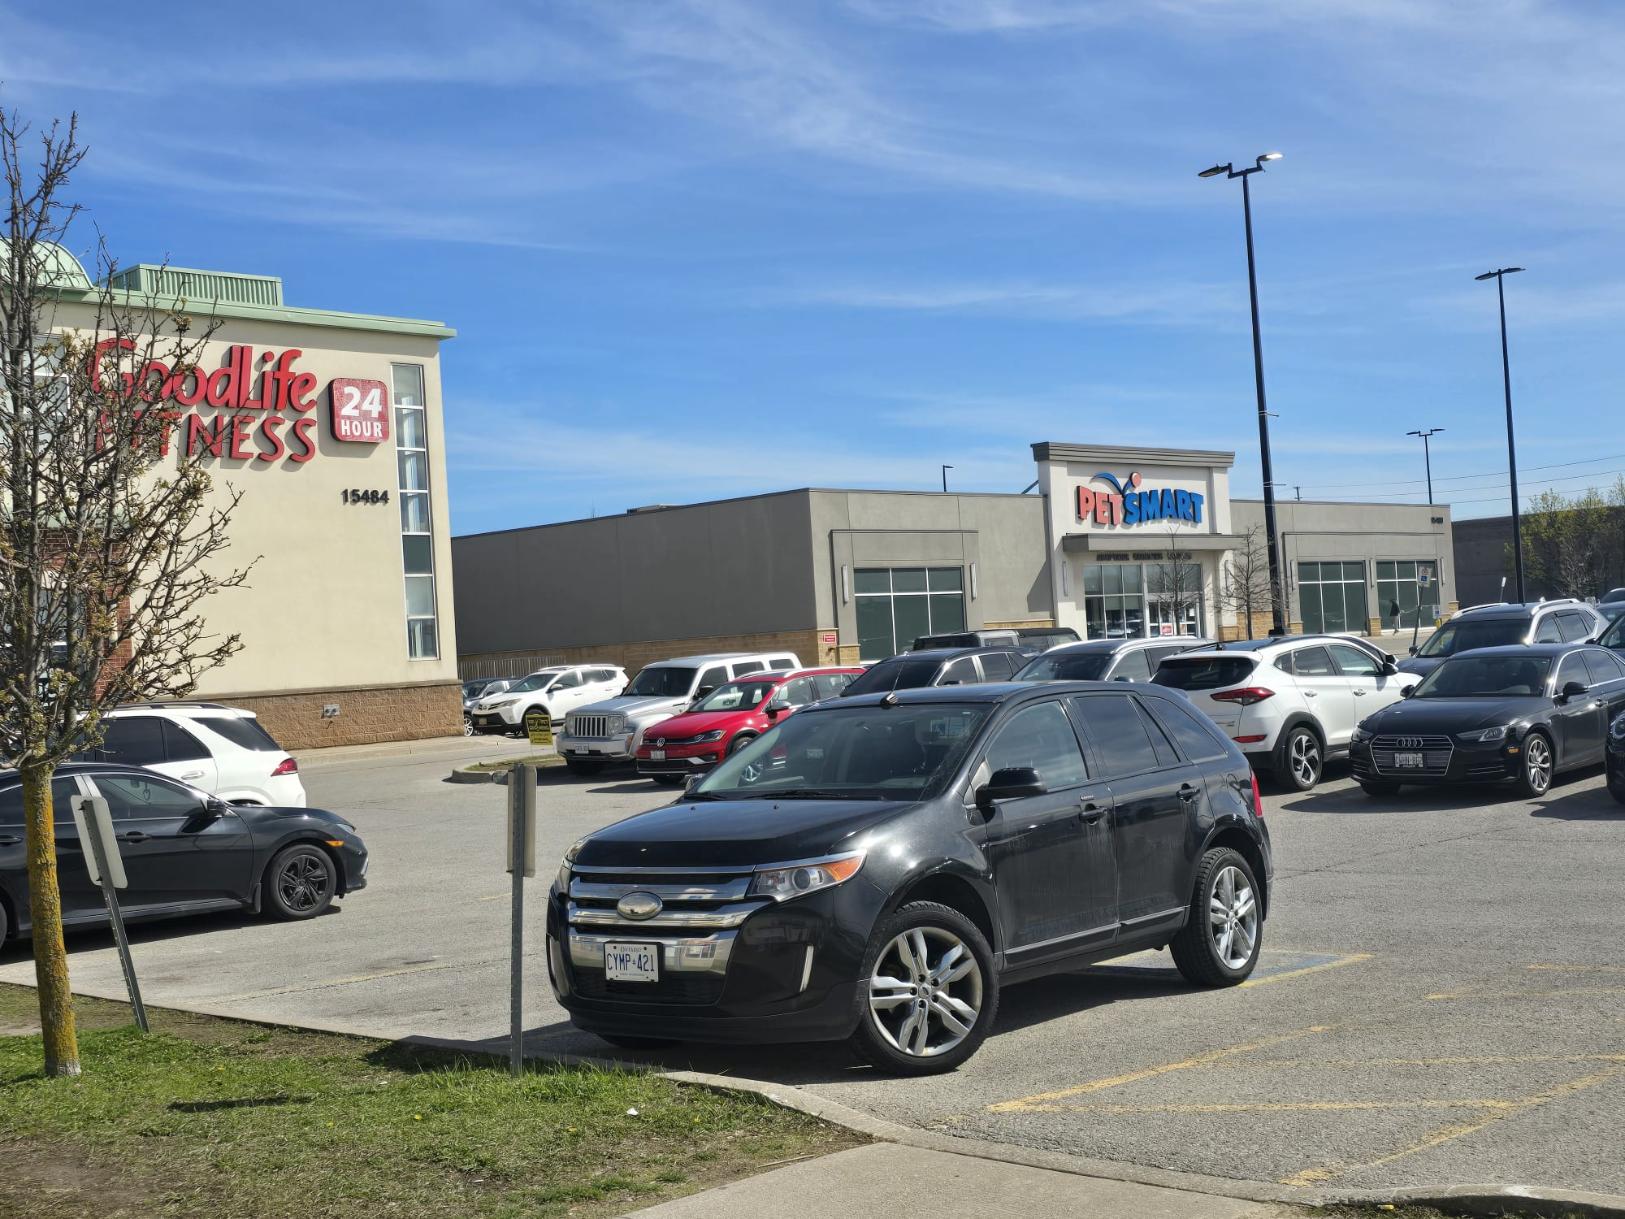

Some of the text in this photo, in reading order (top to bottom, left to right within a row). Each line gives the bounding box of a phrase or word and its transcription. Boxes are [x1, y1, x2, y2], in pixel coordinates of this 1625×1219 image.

[341, 386, 383, 418] 24
[341, 419, 383, 437] HOUR
[341, 488, 389, 505] 15484
